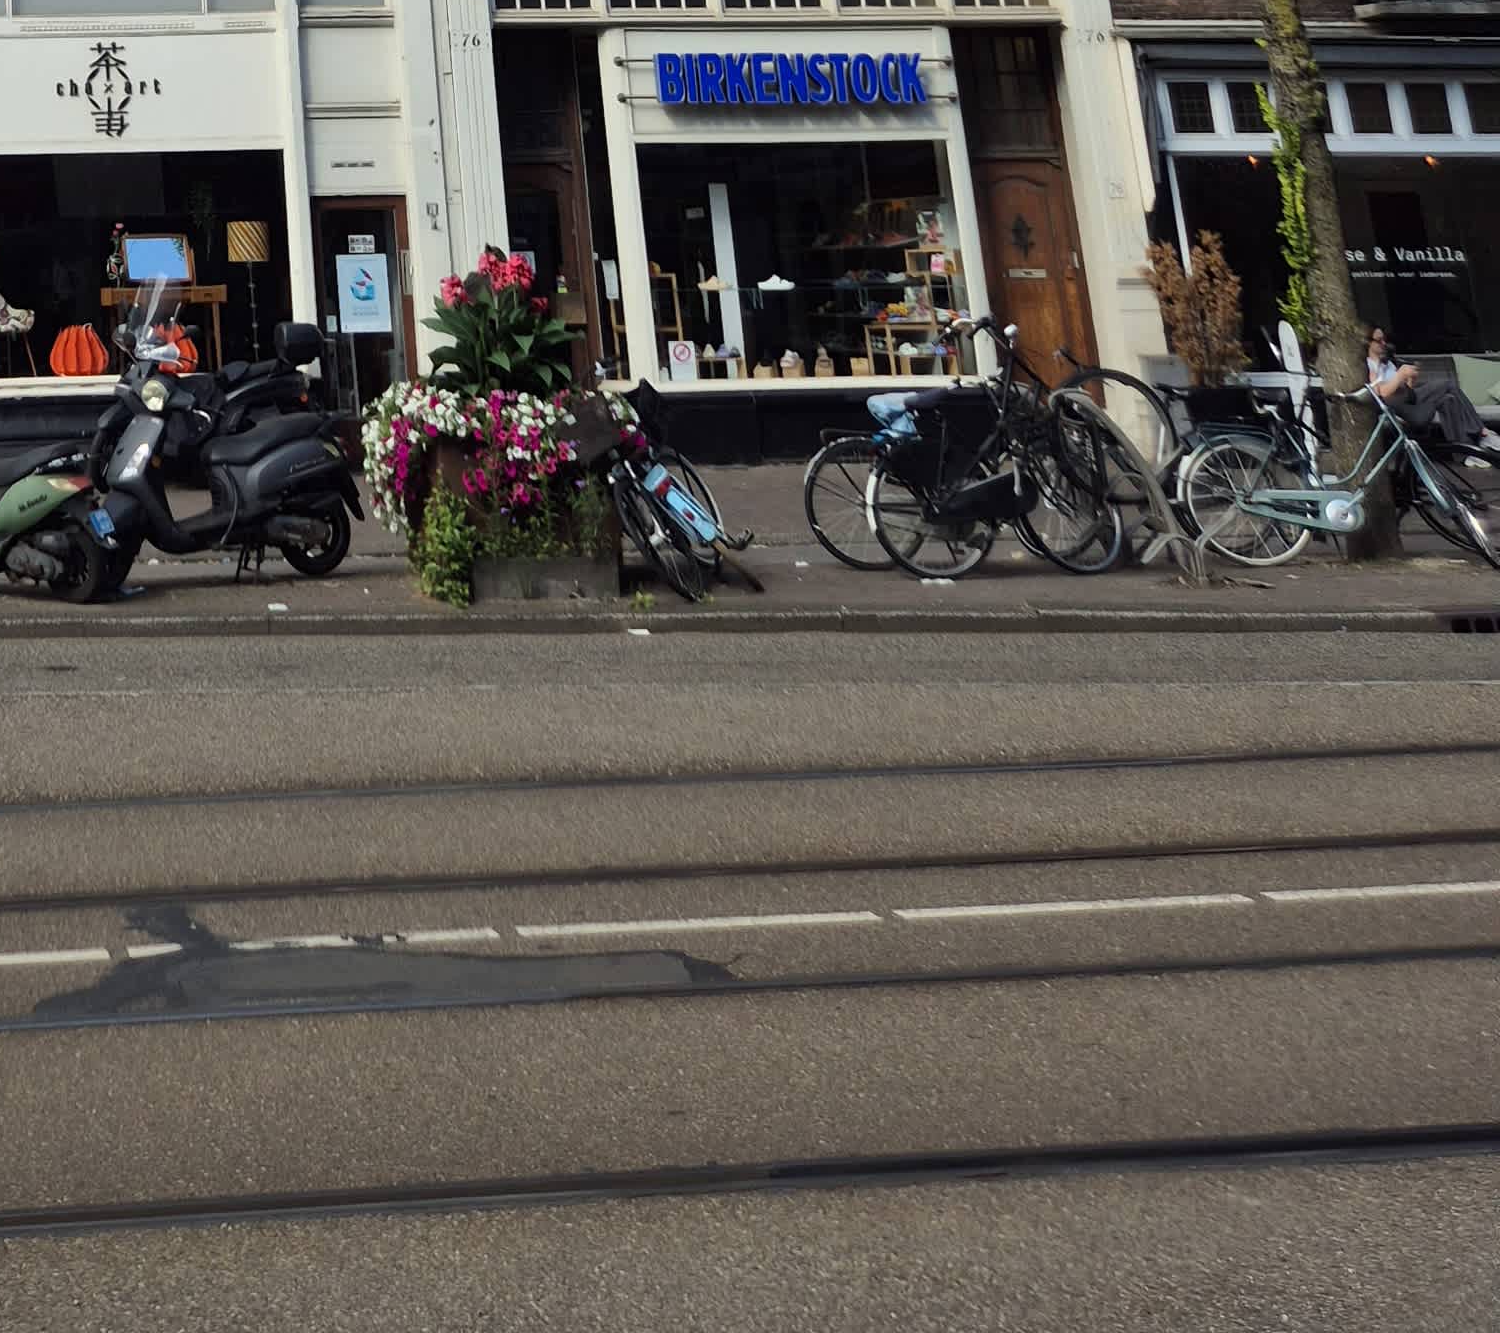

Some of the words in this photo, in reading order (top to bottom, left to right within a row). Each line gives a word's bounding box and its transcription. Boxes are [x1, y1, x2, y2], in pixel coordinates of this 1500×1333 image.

[462, 33, 481, 48] 76
[654, 52, 928, 105] BIRKENSTOCK
[56, 78, 95, 97] cha
[124, 78, 162, 95] art
[1372, 246, 1388, 262] &
[1394, 246, 1467, 262] Vanilla
